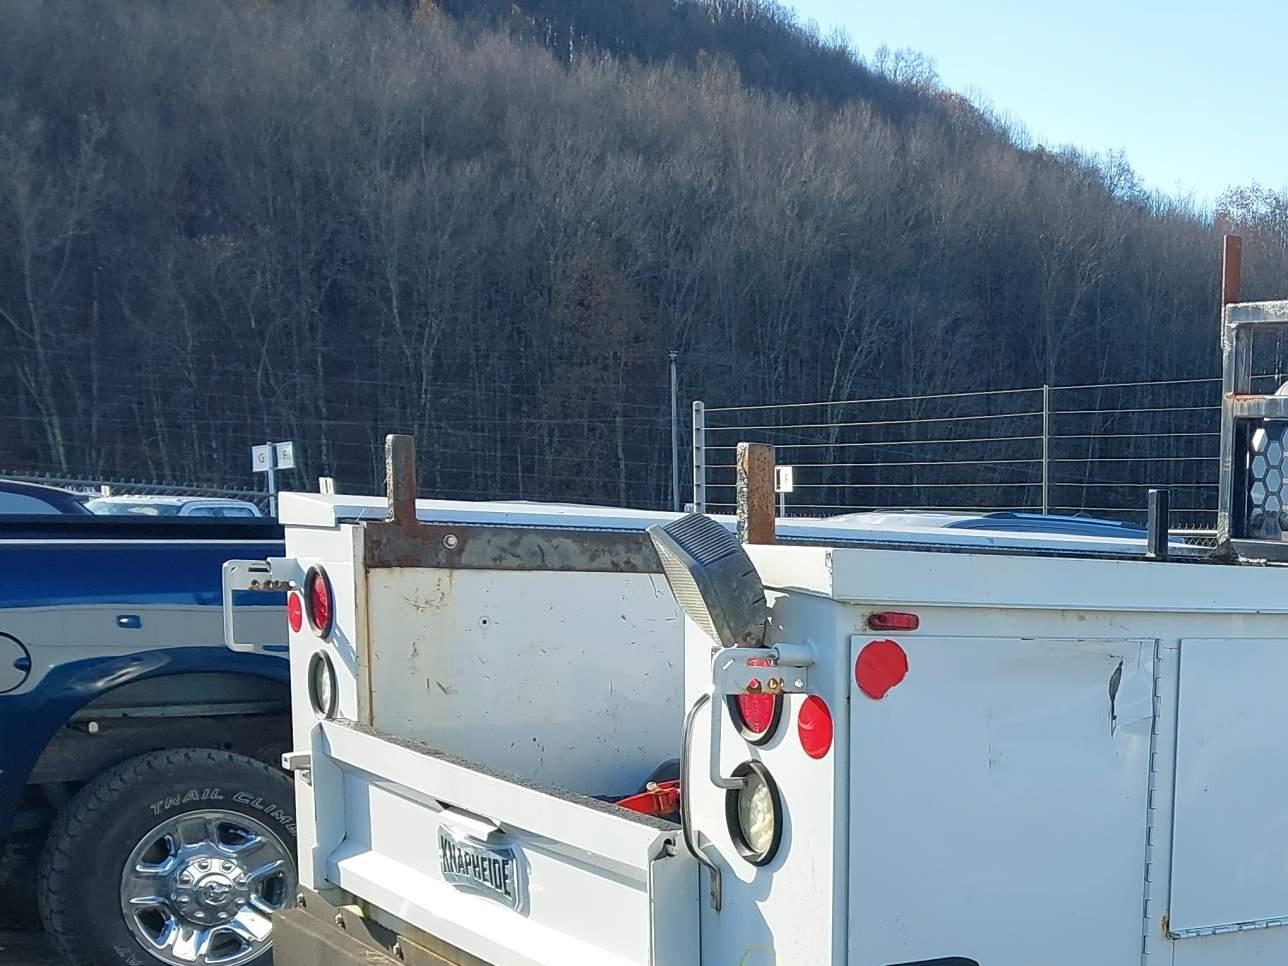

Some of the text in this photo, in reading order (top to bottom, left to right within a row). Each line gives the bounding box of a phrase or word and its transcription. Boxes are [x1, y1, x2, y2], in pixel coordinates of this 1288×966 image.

[258, 453, 265, 464] G
[150, 787, 225, 816] TRAIL
[440, 834, 513, 897] KNAPHEIDE
